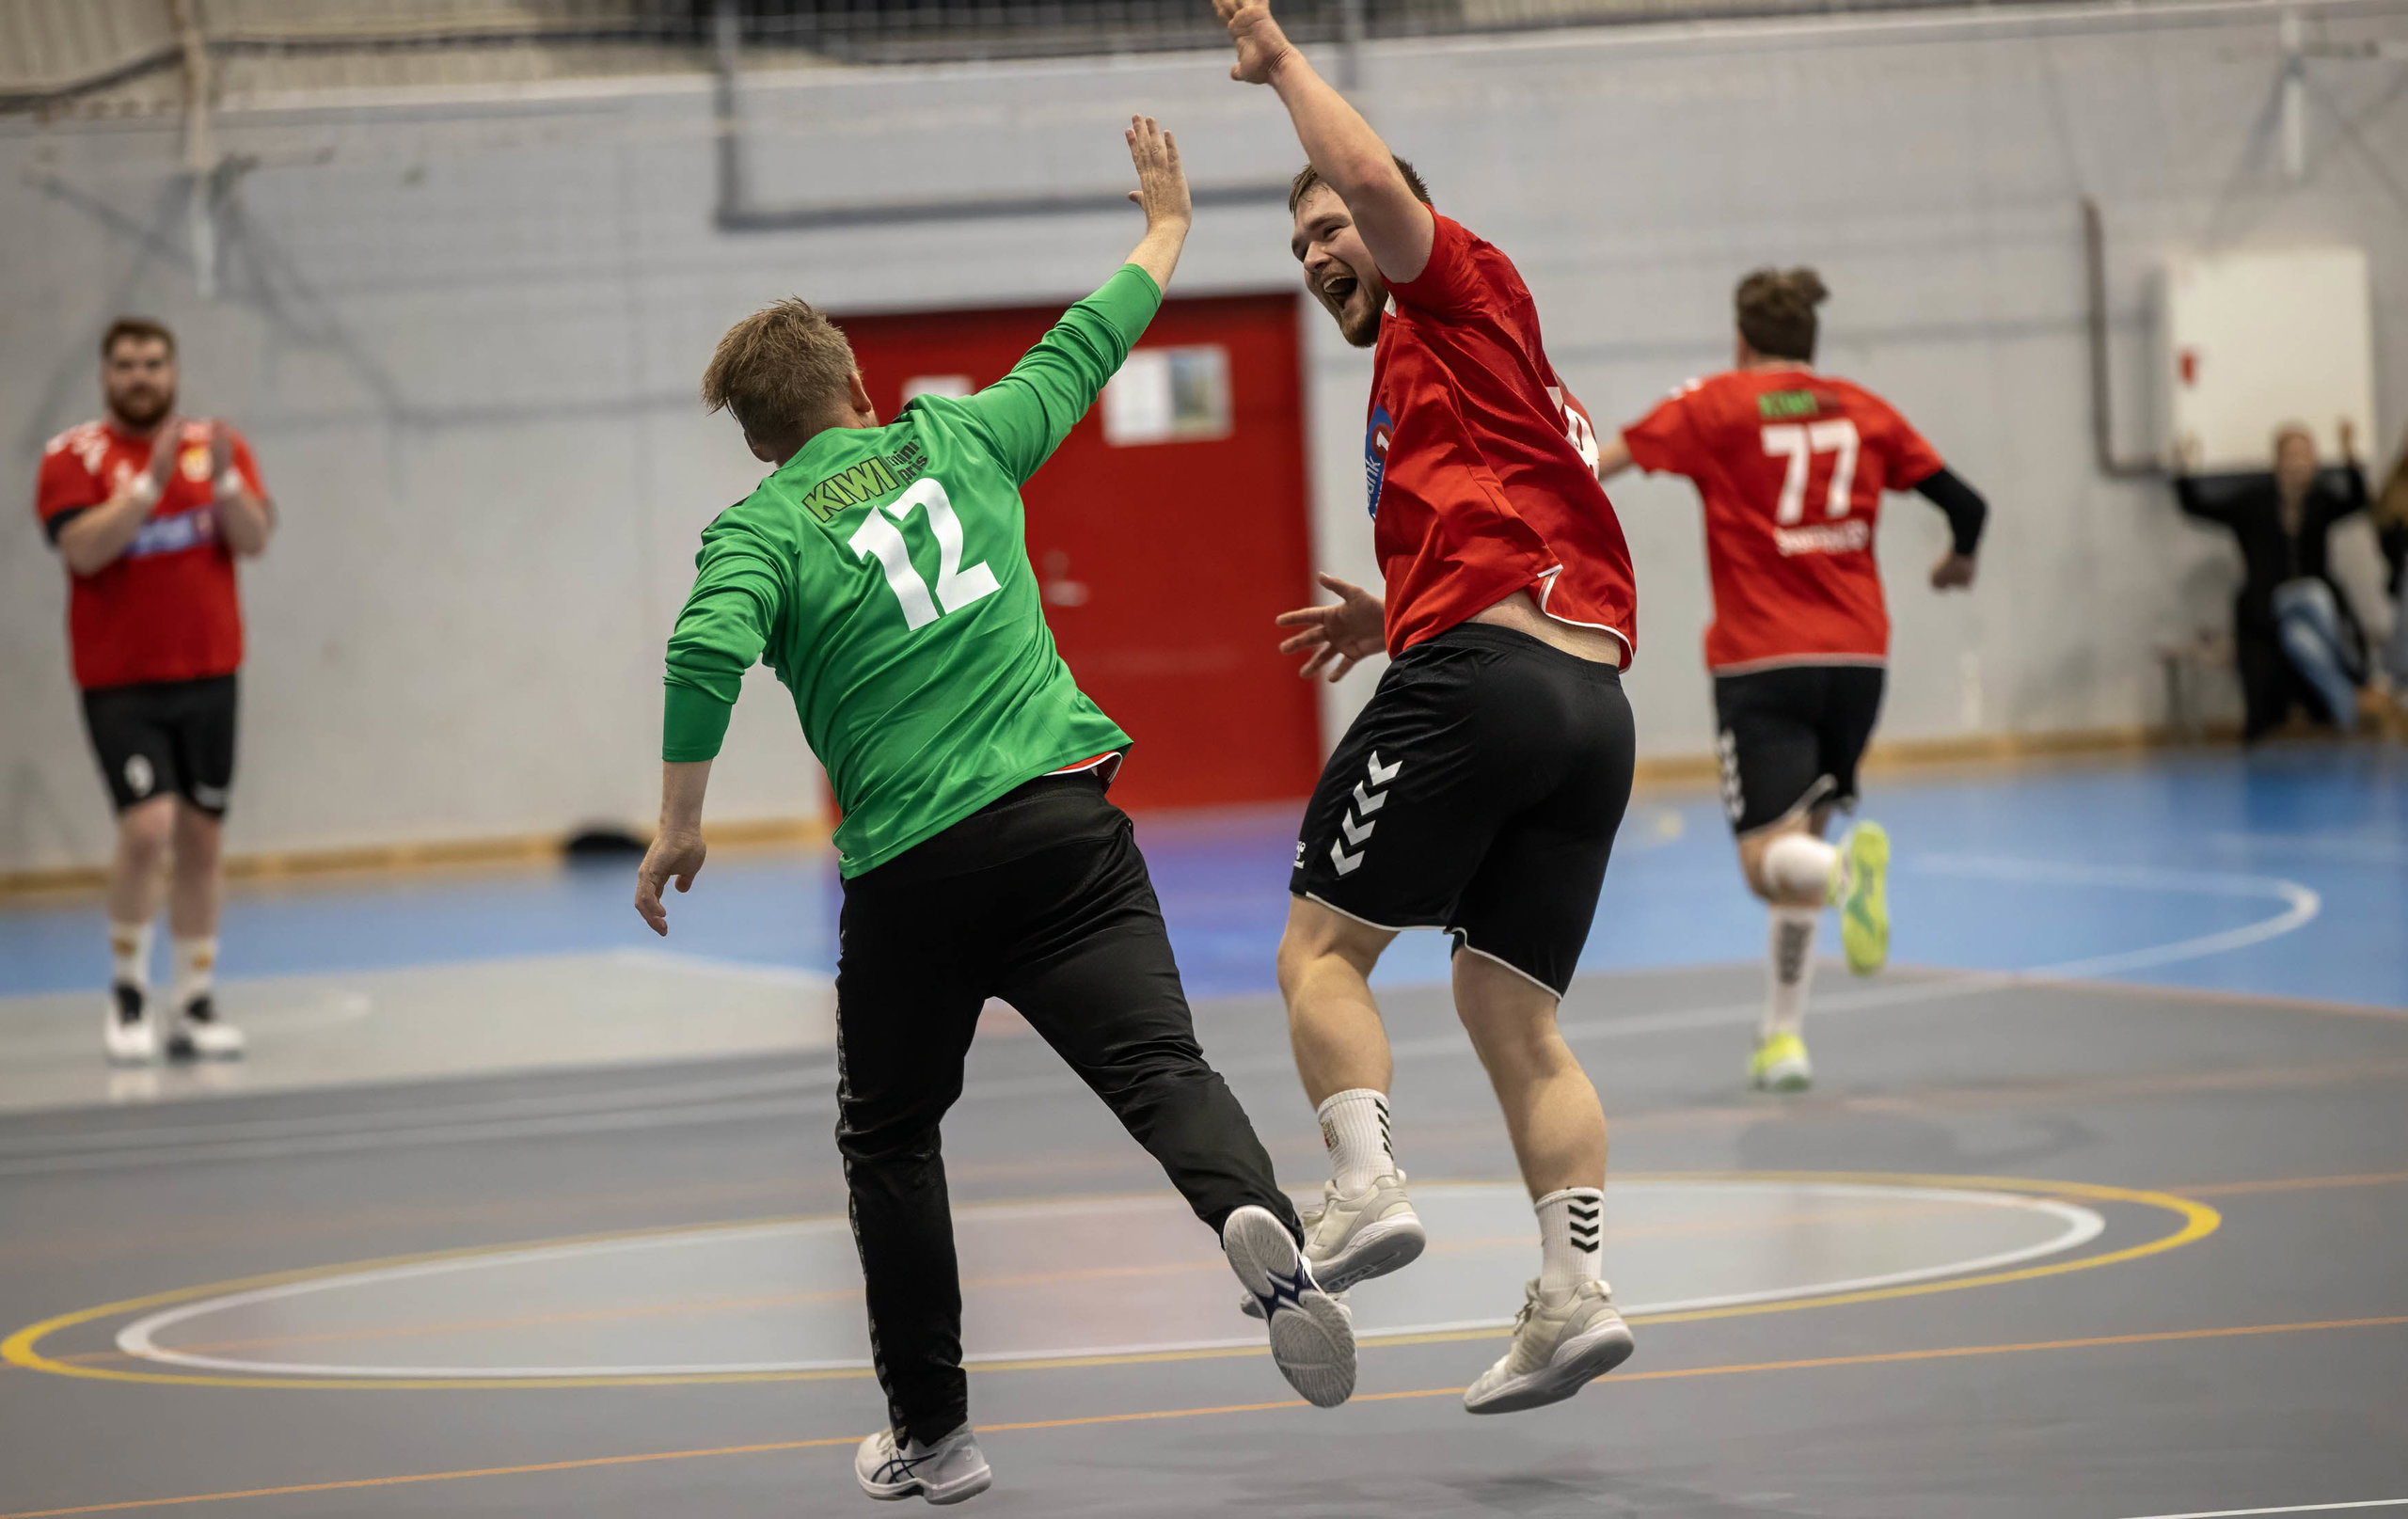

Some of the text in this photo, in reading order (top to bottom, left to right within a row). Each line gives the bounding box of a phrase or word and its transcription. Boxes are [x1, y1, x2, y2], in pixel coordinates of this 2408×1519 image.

[801, 455, 900, 523] KIWI
[1761, 420, 1859, 524] 77
[847, 477, 1002, 631] 12
